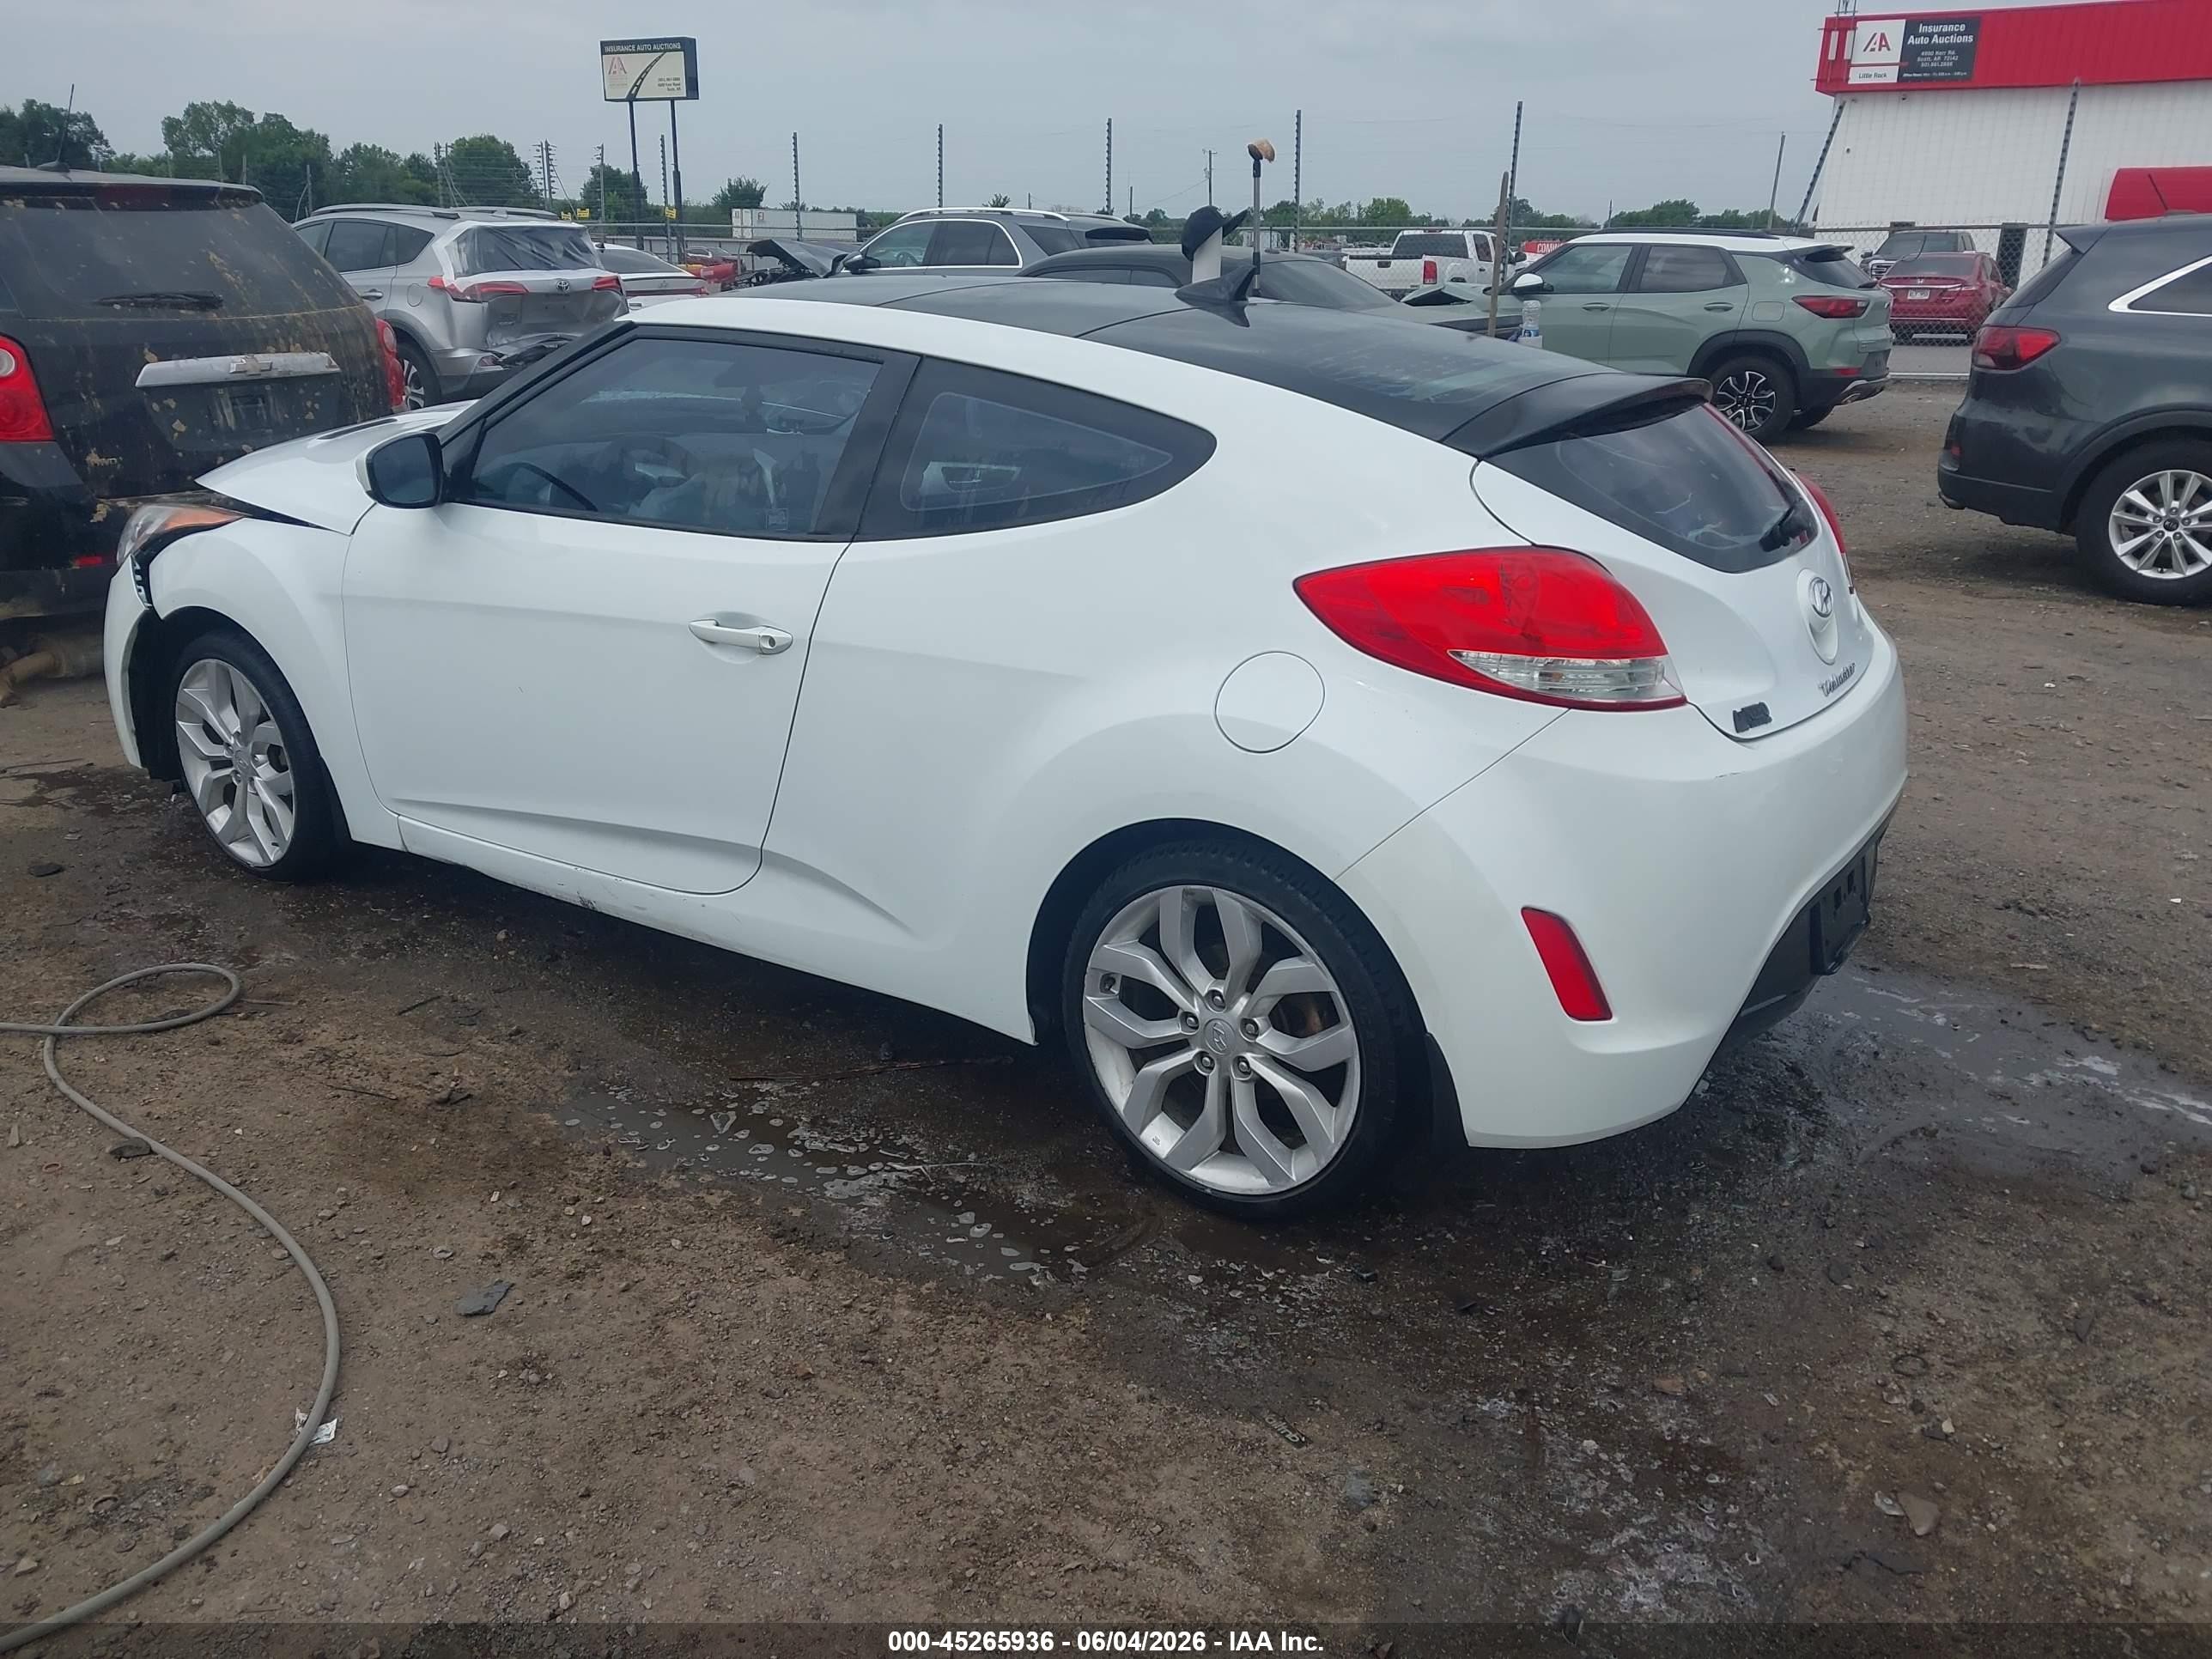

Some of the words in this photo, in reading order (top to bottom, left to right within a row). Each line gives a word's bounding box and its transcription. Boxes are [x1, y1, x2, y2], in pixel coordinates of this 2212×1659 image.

[1918, 22, 1966, 33] Insurance
[1907, 33, 1929, 45] Auto
[1930, 33, 1974, 45] Auctions
[605, 44, 635, 52] INSURANCE
[636, 43, 652, 52] AUTO
[653, 42, 681, 51] AUCTIONS
